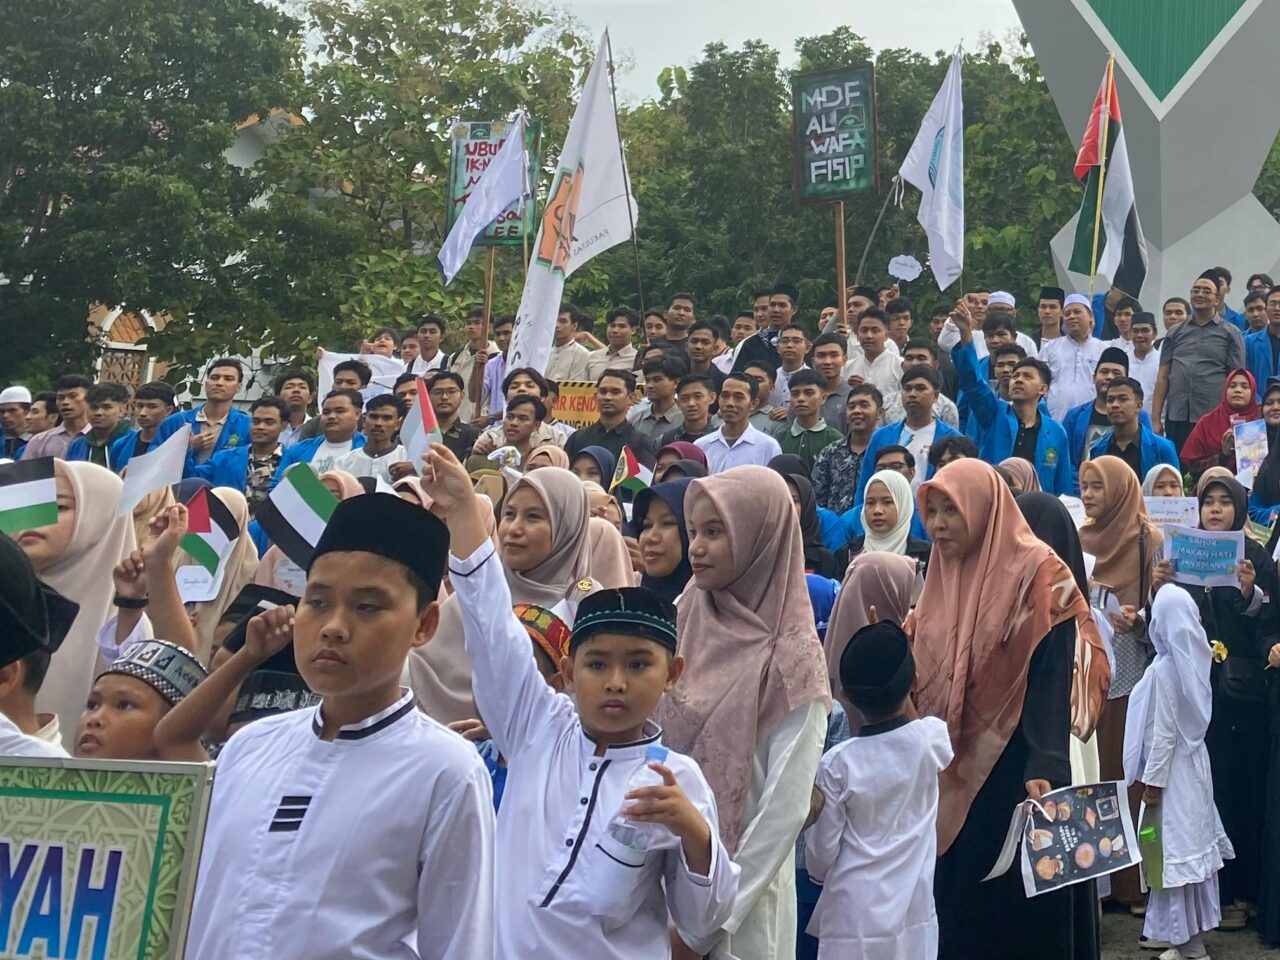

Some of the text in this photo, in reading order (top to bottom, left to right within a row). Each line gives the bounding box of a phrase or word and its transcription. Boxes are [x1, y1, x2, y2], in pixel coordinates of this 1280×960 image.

[801, 81, 860, 113] MDF
[805, 114, 836, 136] AL
[810, 129, 866, 154] WAFA
[810, 154, 864, 183] FISIP
